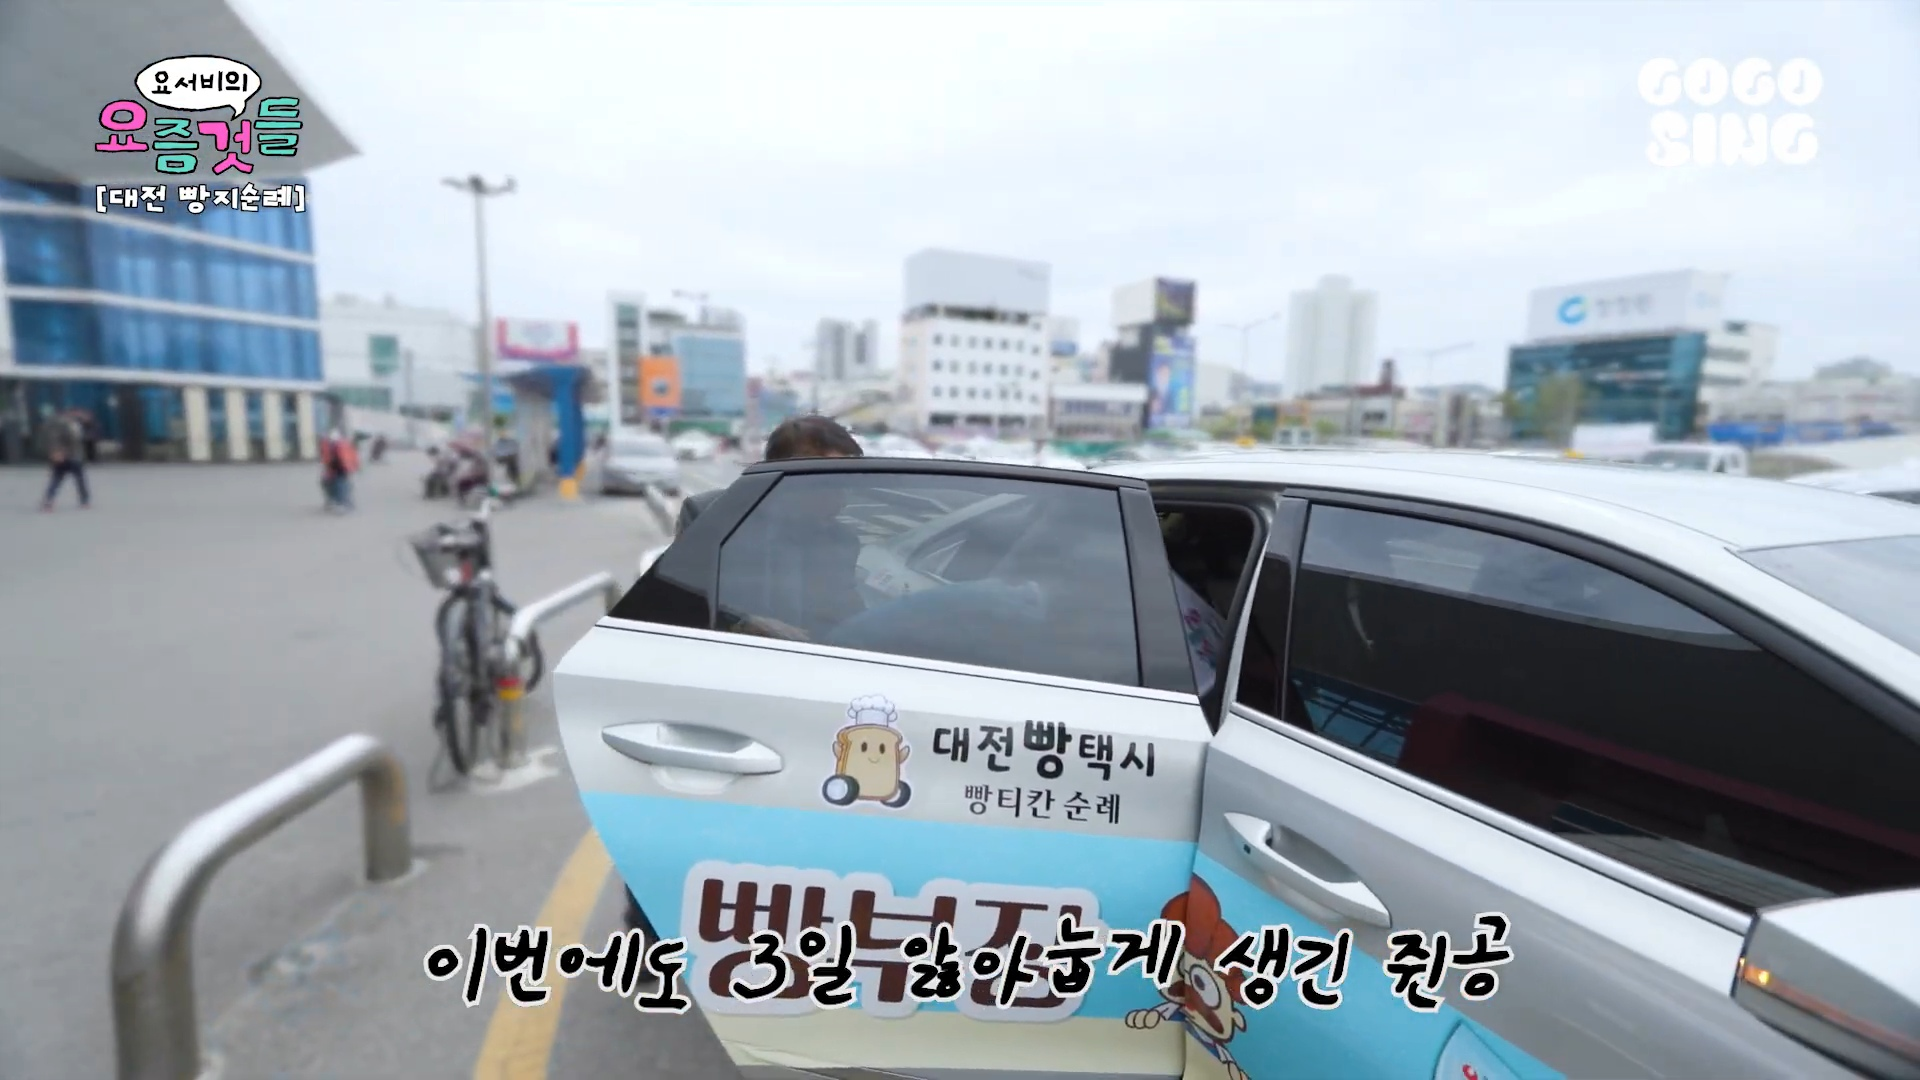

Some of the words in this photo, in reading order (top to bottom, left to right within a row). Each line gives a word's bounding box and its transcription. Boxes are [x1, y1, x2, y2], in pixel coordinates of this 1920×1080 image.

[933, 719, 1155, 781] 대전빵택시
[965, 784, 1055, 820] 빵티칸
[1063, 791, 1121, 824] 순례
